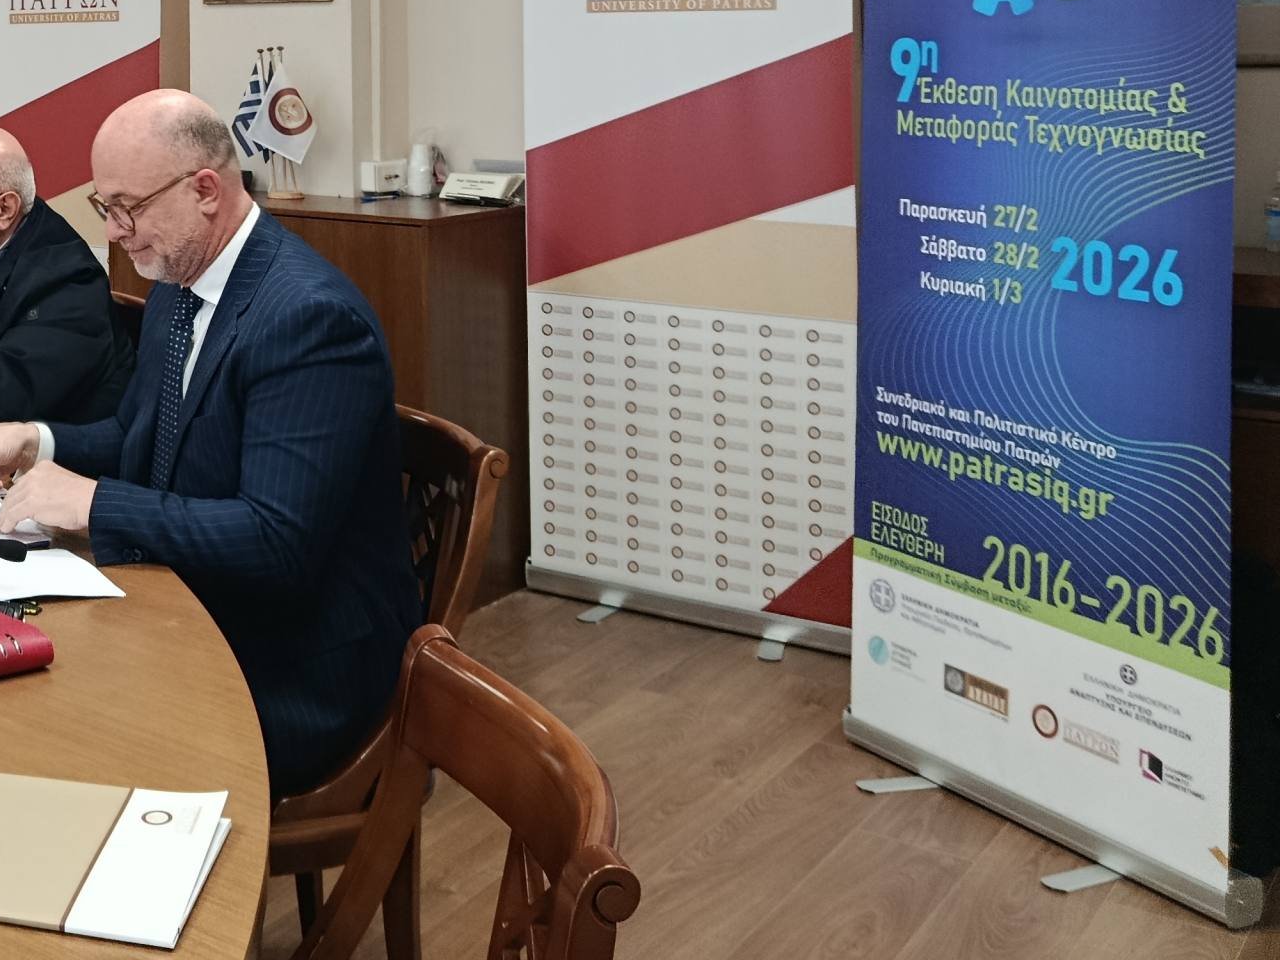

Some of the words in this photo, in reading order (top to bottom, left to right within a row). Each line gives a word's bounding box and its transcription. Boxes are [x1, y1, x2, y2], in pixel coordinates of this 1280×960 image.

[12, 13, 64, 23] UNIVERSITY
[67, 13, 79, 22] OF
[82, 12, 117, 22] PATRAS
[916, 77, 998, 110] Έκθεση
[1006, 77, 1158, 116] Καινοτομίας
[1167, 82, 1189, 114] &
[897, 109, 1018, 147] Μεταφοράς
[1025, 115, 1206, 159] Τεχνογνωσίας
[899, 198, 987, 228] Παρασκευή
[993, 204, 1039, 232] 27/2
[920, 235, 987, 262] Σάββατο
[993, 241, 1039, 270] 28/2
[1050, 236, 1184, 307] 2026
[920, 272, 986, 302] Κυριακή
[992, 278, 1022, 306] 1/3
[876, 386, 946, 418] Συνεδριακό
[948, 406, 971, 425] και
[974, 410, 1058, 444] Πολιτιστικό
[1061, 429, 1117, 460] Κέντρο
[876, 411, 899, 428] του
[902, 415, 1001, 454] Πανεπιστημίου
[1005, 441, 1061, 470] Πατρών
[876, 430, 1115, 520] www.patrasiq.gr
[871, 500, 929, 536] ΕΙΣΟΔΟΣ
[871, 521, 945, 565] ΕΛΕΥΘΕΡΗ
[982, 535, 1224, 663] 2016-2026
